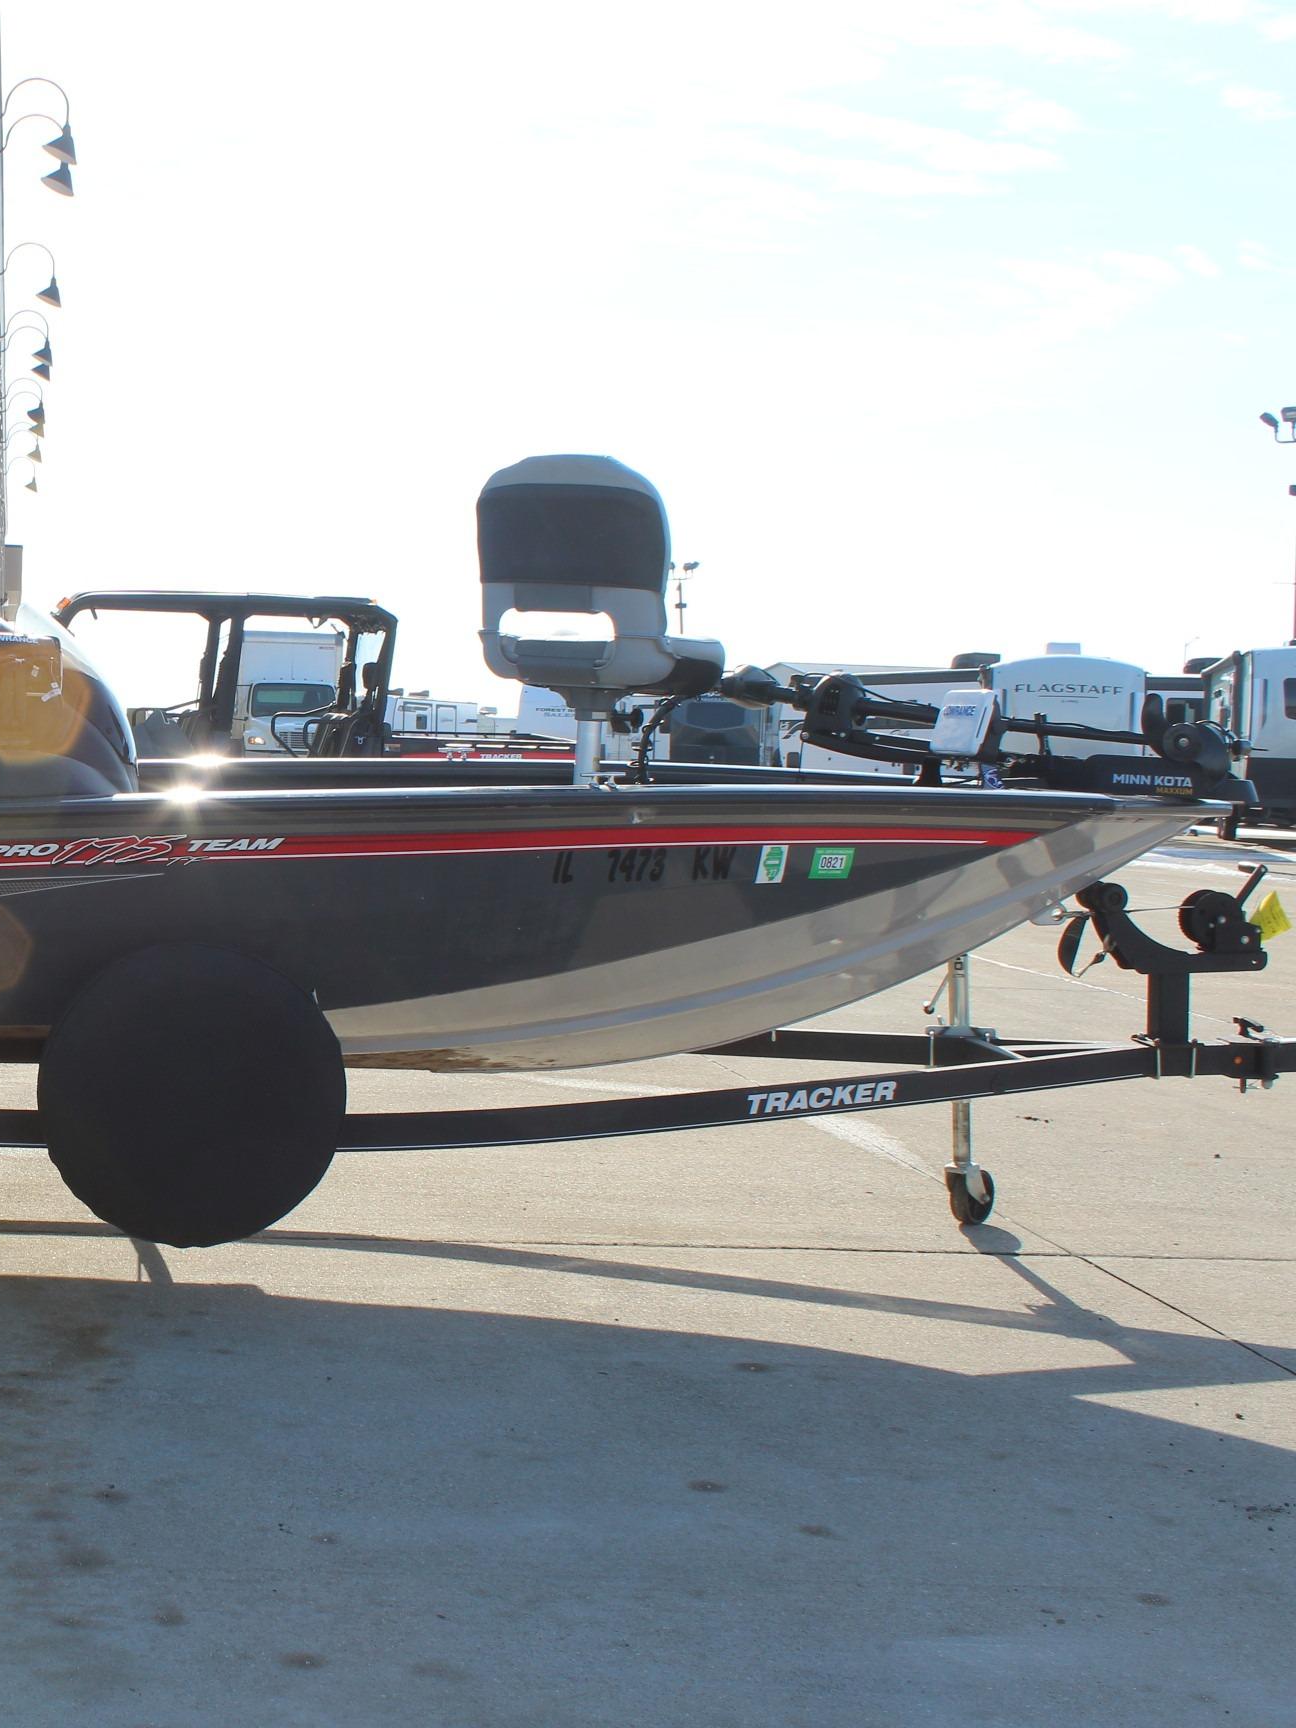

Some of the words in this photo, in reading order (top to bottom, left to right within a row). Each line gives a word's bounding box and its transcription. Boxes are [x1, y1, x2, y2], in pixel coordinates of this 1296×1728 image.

[1015, 684, 1123, 695] FLAGSTAFF
[1112, 773, 1152, 785] MINN
[1154, 775, 1193, 787] KOTA
[51, 835, 187, 866] 175
[188, 837, 285, 852] TEAM
[553, 851, 573, 884] IL
[692, 846, 737, 881] KW
[820, 856, 844, 869] 0821
[747, 1081, 897, 1115] TRACKER
